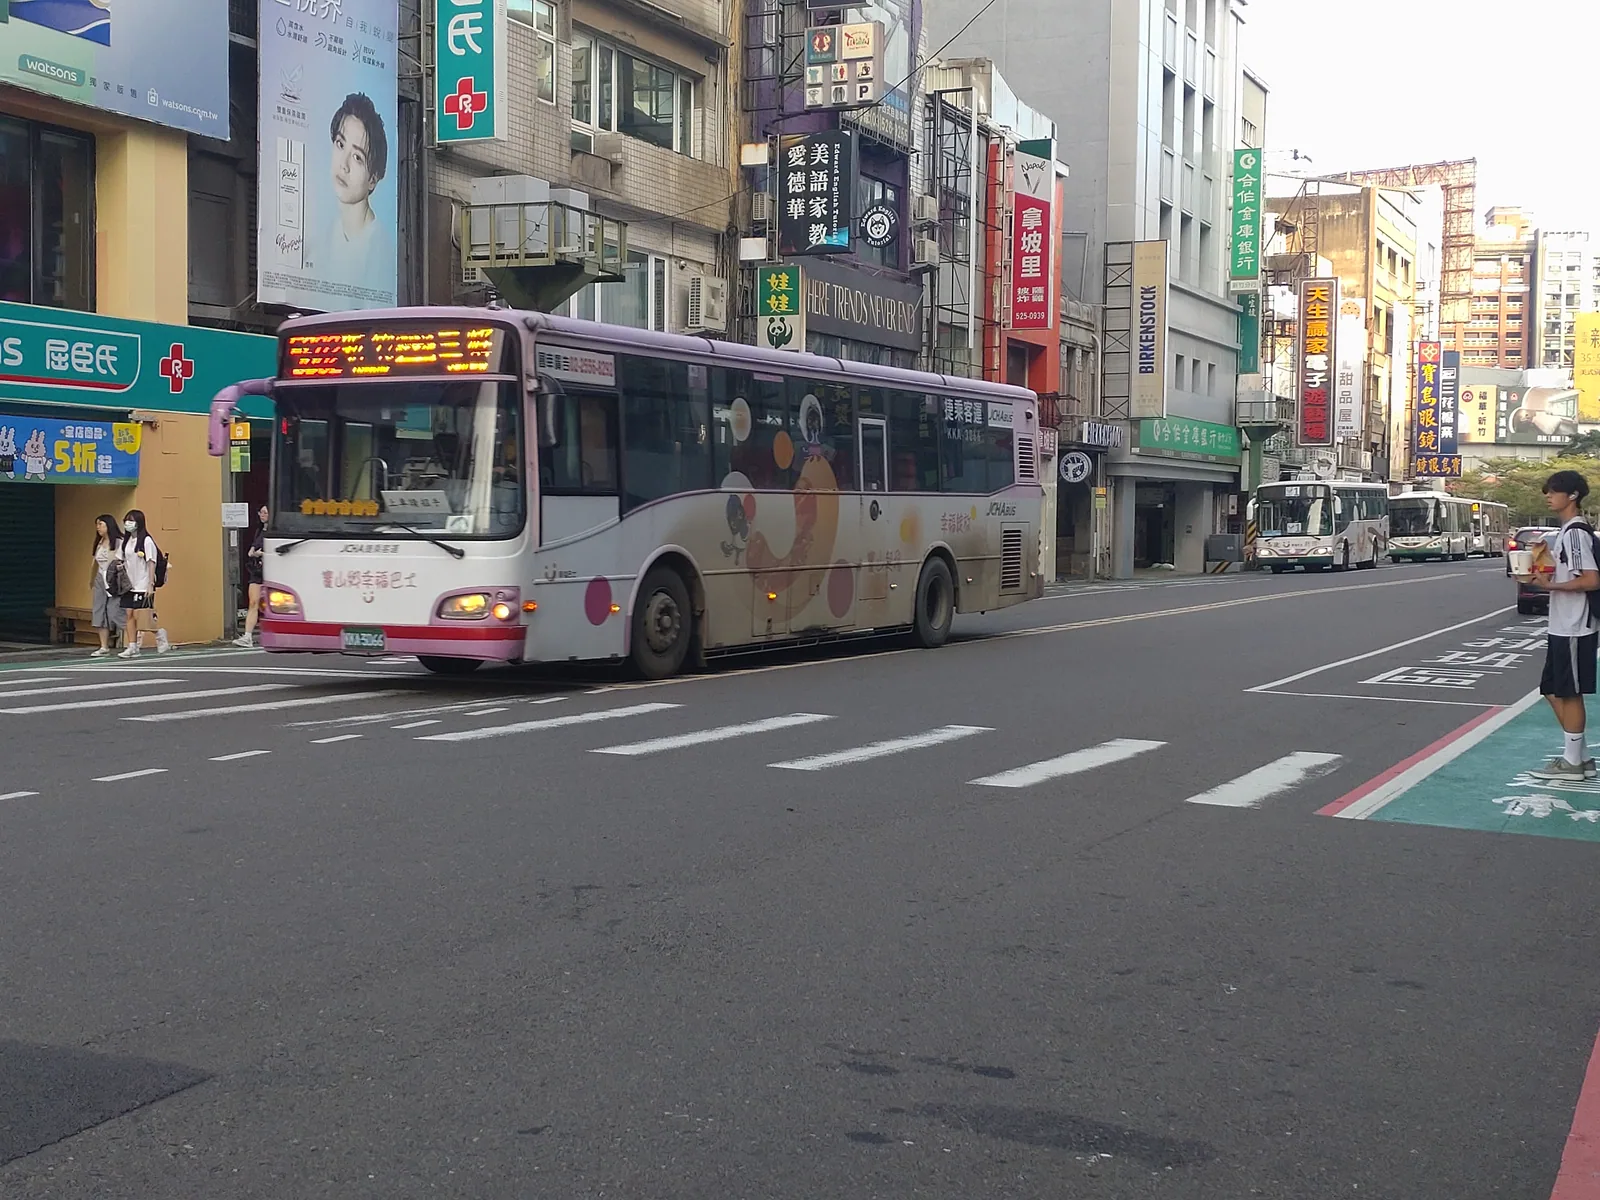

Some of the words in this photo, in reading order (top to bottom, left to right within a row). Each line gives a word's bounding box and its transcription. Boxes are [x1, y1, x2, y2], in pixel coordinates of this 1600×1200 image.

[26, 58, 77, 82] watsons
[161, 98, 218, 120] watsons.com.tw
[786, 144, 807, 220] 愛德華
[806, 143, 829, 250] 美語家教
[1020, 207, 1044, 278] 拿坡里
[1236, 173, 1258, 271] 合作金庫銀行
[766, 272, 794, 313] 娃娃
[832, 284, 869, 326] TRENDS
[869, 294, 897, 332] NEVER
[898, 301, 916, 335] END
[1015, 311, 1045, 320] 525-0939
[46, 338, 118, 376] 屈臣氏
[1138, 285, 1157, 374] BIRKENSTOCK
[1418, 363, 1438, 450] 寶島眼鏡
